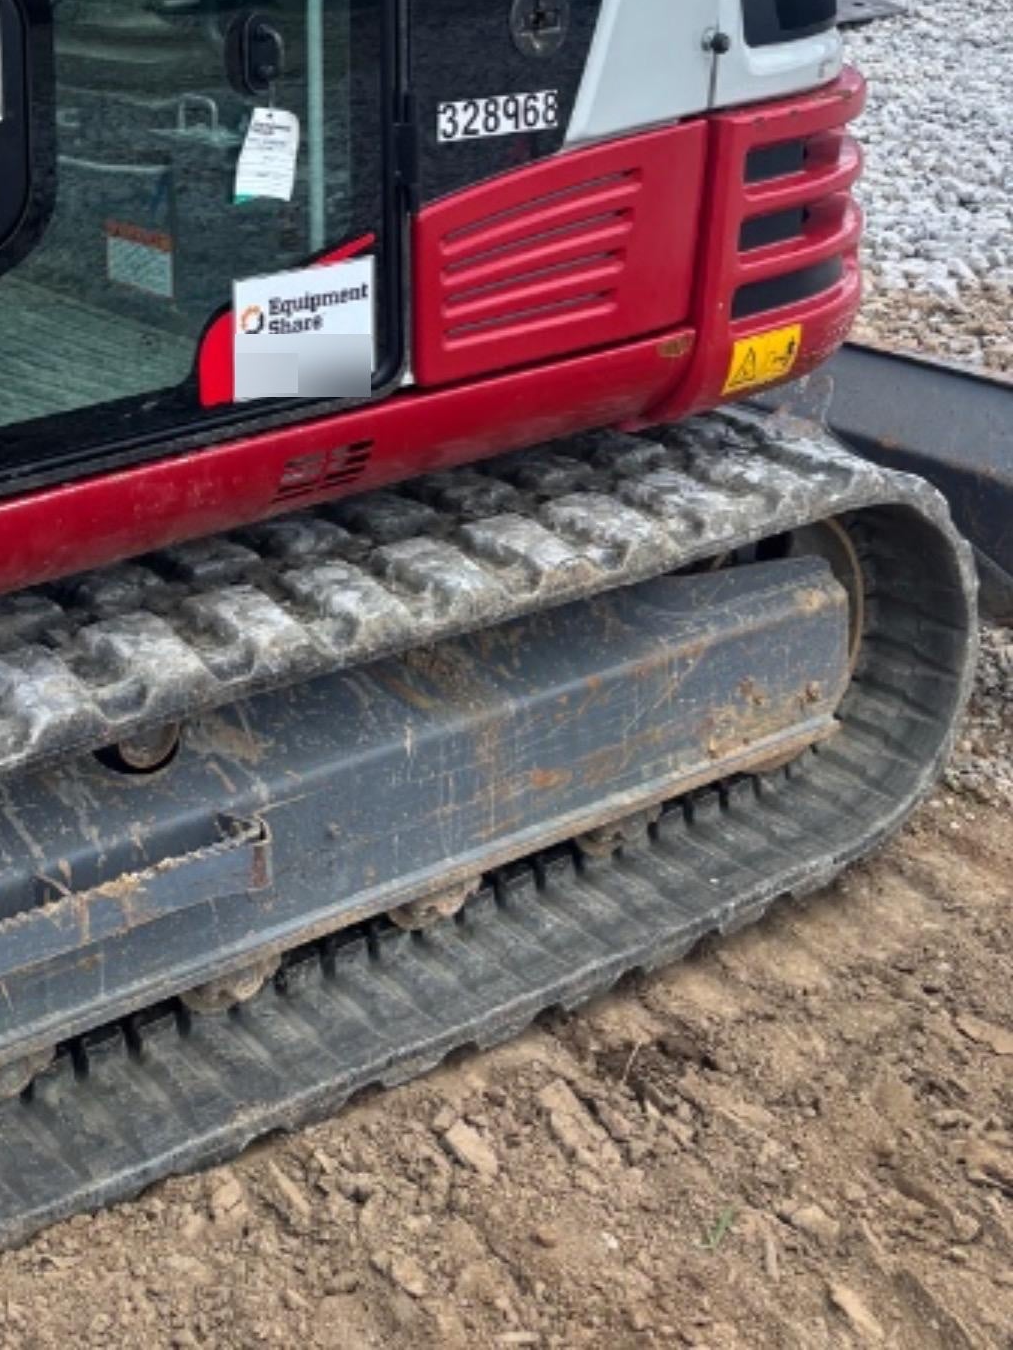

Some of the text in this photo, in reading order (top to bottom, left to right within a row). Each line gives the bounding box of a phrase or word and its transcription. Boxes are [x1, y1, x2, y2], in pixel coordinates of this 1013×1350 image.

[437, 91, 558, 139] 328968
[268, 282, 369, 317] Equipment
[268, 314, 324, 335] Share
